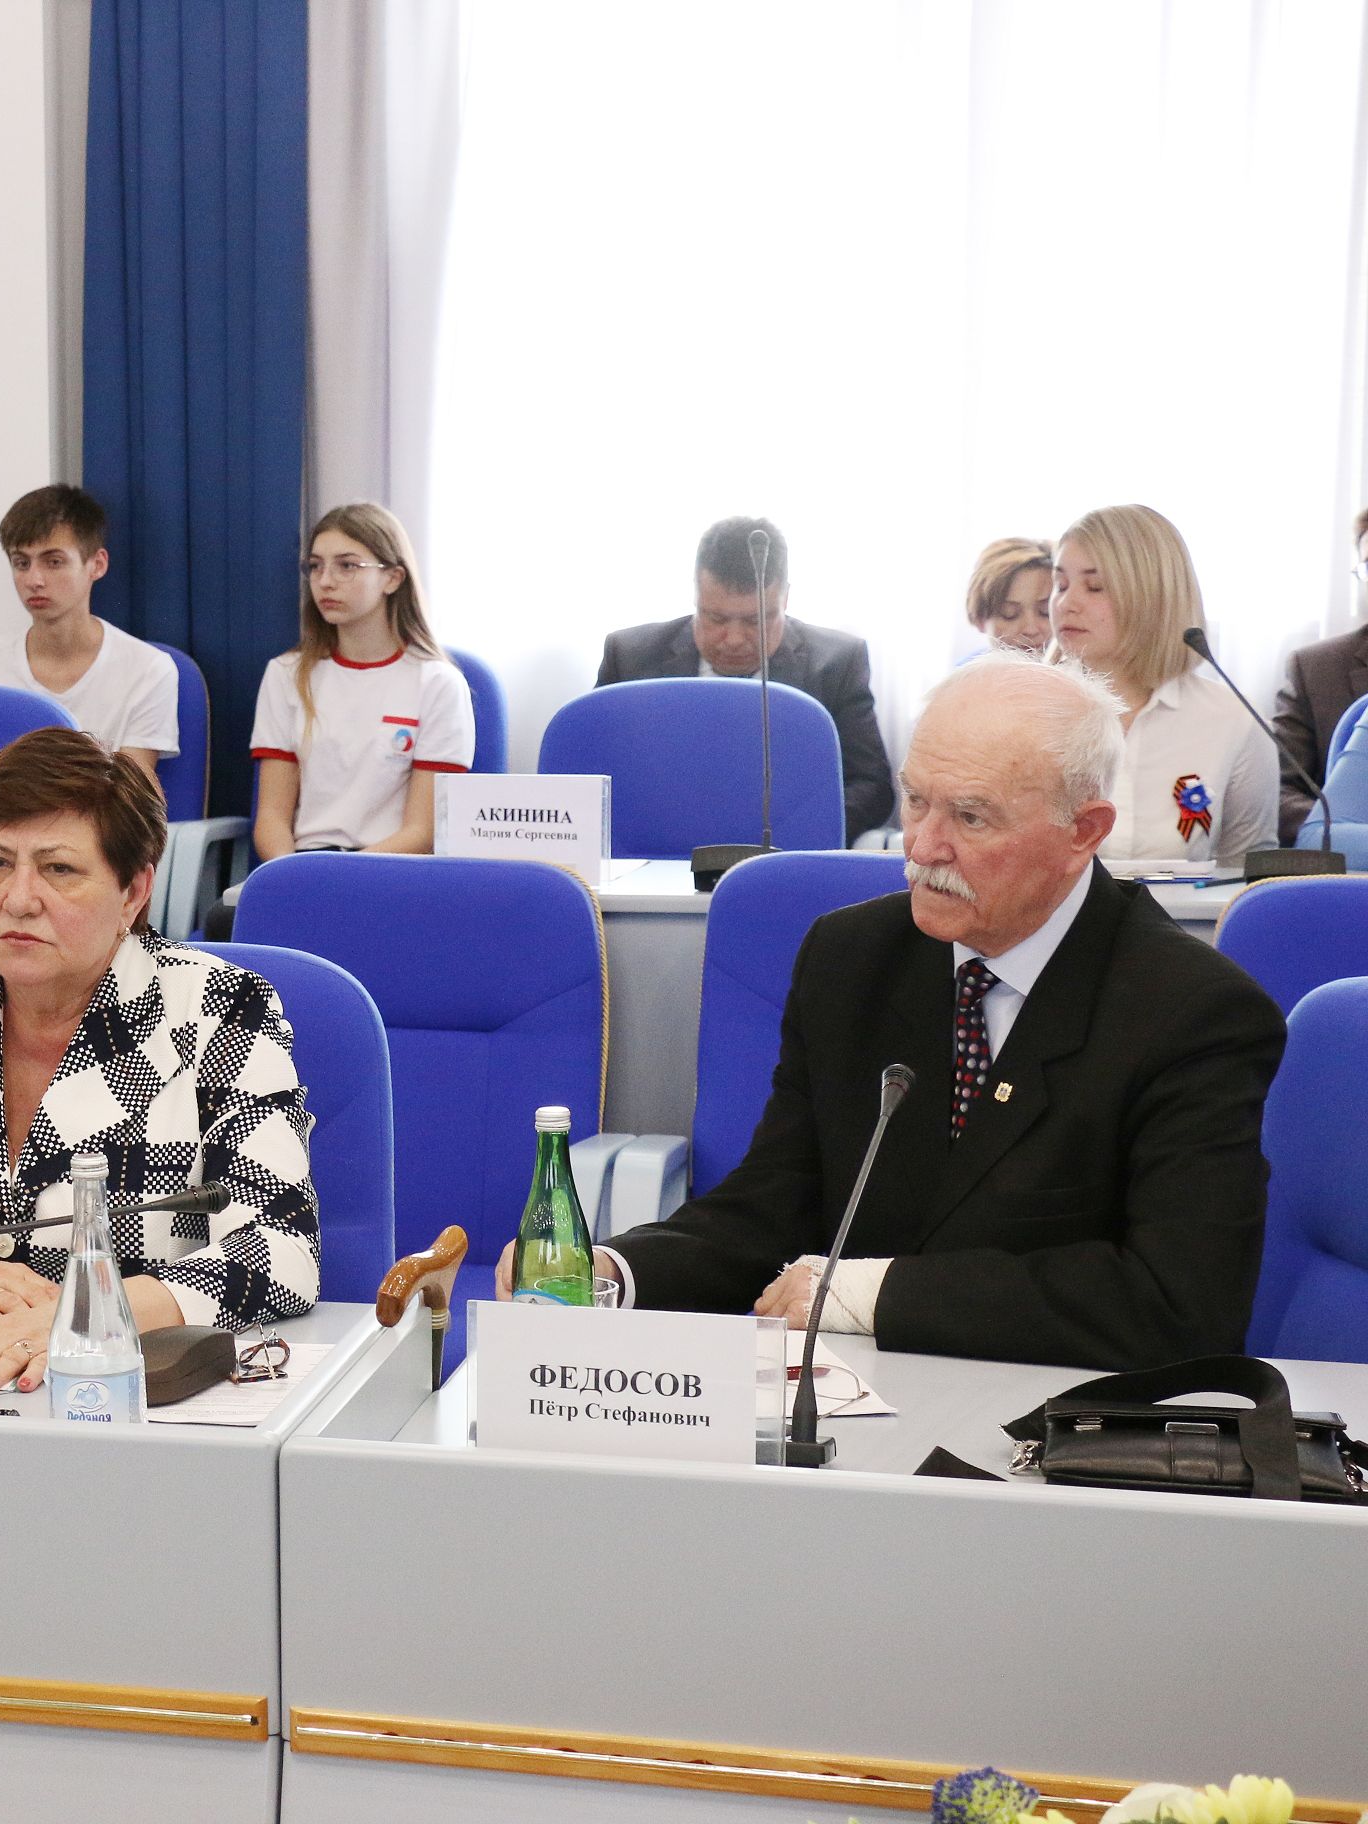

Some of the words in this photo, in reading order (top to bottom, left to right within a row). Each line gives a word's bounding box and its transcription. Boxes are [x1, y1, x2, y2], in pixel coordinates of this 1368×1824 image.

[475, 807, 573, 824] АКИНИНА
[471, 827, 512, 840] Мария
[514, 828, 578, 842] Сергеевна
[529, 1364, 703, 1398] ФЕДОСОВ
[528, 1398, 579, 1422] Пётр
[584, 1402, 711, 1427] Стефанович
